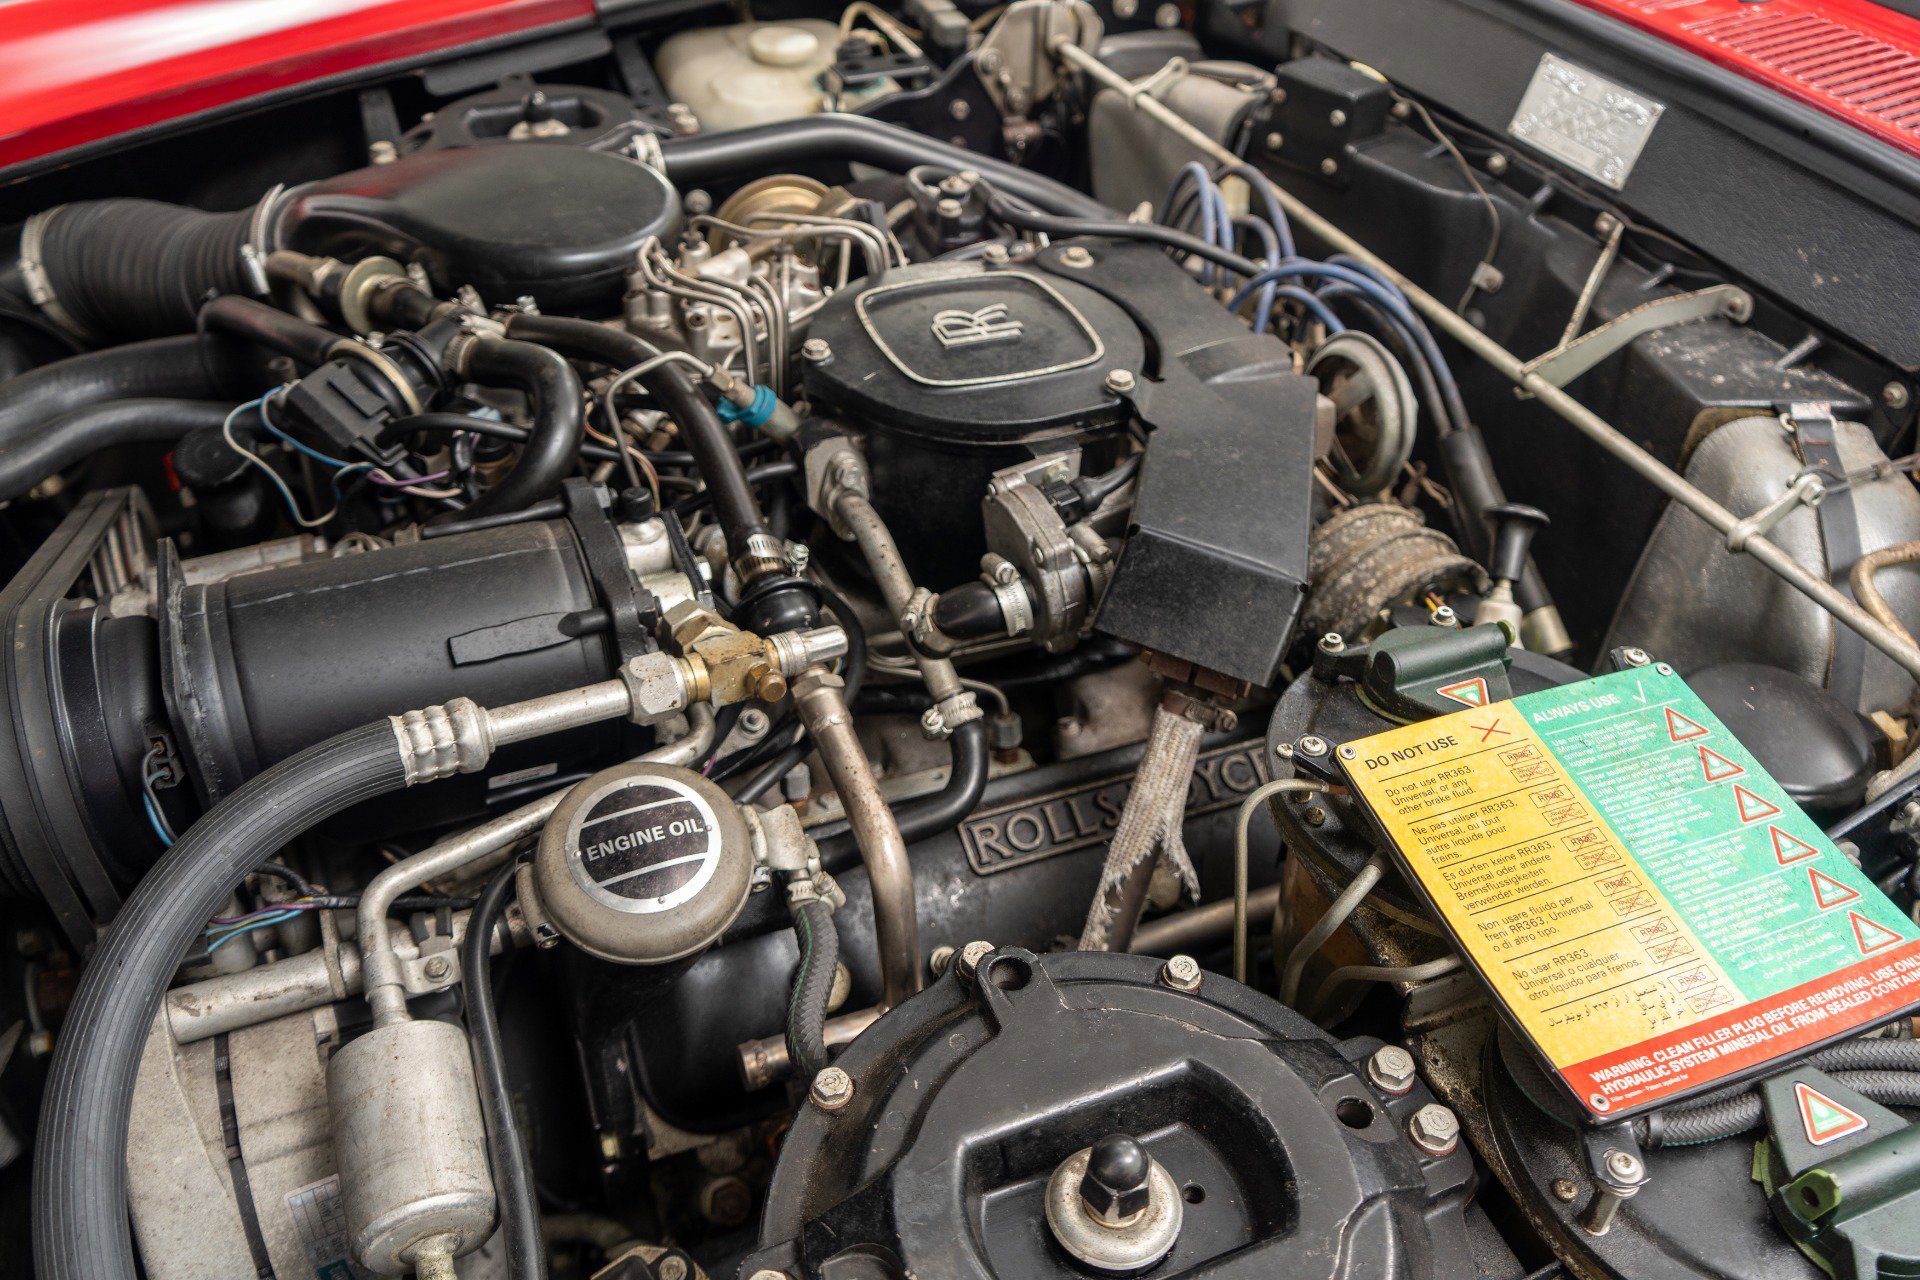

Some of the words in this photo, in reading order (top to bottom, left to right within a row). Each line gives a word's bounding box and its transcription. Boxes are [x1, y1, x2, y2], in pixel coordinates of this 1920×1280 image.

[1533, 700, 1591, 723] ALWAYS
[1588, 693, 1619, 708] USE
[1364, 755, 1389, 770] DO
[1390, 744, 1423, 762] NOT
[1425, 735, 1458, 751] USE
[1384, 788, 1400, 797] Do
[1401, 782, 1418, 792] not
[1419, 777, 1436, 787] use
[1437, 765, 1475, 781] RR363,
[1390, 787, 1438, 806] Universal,
[1451, 778, 1470, 788] any
[1398, 802, 1422, 814] other
[1423, 795, 1451, 807] brake
[1451, 786, 1476, 798] fluid.
[1411, 827, 1427, 835] Ne
[1428, 821, 1446, 832] pas
[1448, 811, 1478, 825] utiliser
[1480, 799, 1517, 815] RR363,
[586, 825, 666, 862] ENGINE
[668, 818, 704, 837] OIL
[1417, 825, 1466, 845] Universal,
[1466, 822, 1480, 830] ou
[1481, 815, 1500, 826] tout
[1425, 842, 1450, 854] autre
[1450, 832, 1484, 846] liquide
[1485, 825, 1507, 838] pour
[1431, 851, 1462, 864] freins.
[1442, 872, 1456, 881] Es
[1489, 853, 1516, 866] keine
[1516, 840, 1555, 857] RR363,
[1448, 870, 1494, 890] Universal
[1496, 864, 1516, 876] oder
[1519, 854, 1551, 869] andere
[1463, 889, 1513, 910] verwendet
[1514, 878, 1553, 894] werden.
[1476, 920, 1500, 932] Non
[1501, 911, 1528, 924] usare
[1528, 901, 1557, 915] fluido
[1558, 896, 1574, 907] per
[1484, 930, 1508, 941] freni
[1508, 916, 1548, 933] RR363,
[1547, 900, 1593, 921] Universal
[1501, 939, 1512, 949] di
[1513, 933, 1536, 945] altro
[1536, 926, 1559, 937] tipo.
[1511, 970, 1528, 980] No
[1530, 962, 1551, 974] usar
[1552, 948, 1591, 966] RR363,
[1518, 968, 1566, 990] Universal
[1576, 953, 1619, 972] cualquier
[1528, 989, 1549, 1001] otro
[1585, 970, 1607, 983] para
[1606, 959, 1641, 974] frenos.
[1653, 1040, 1695, 1062] CLEAN
[1691, 1027, 1734, 1049] FILLER
[1731, 1015, 1765, 1035] PLUG
[1761, 999, 1810, 1023] BEFORE
[1870, 965, 1897, 981] USE
[1599, 1064, 1671, 1095] HYDRAULIC
[1668, 1047, 1719, 1072] SYSTEM
[1716, 1029, 1774, 1055] MINERAL
[1770, 1021, 1794, 1035] OIL
[1789, 1007, 1829, 1028] FROM
[1825, 990, 1872, 1015] SEALED
